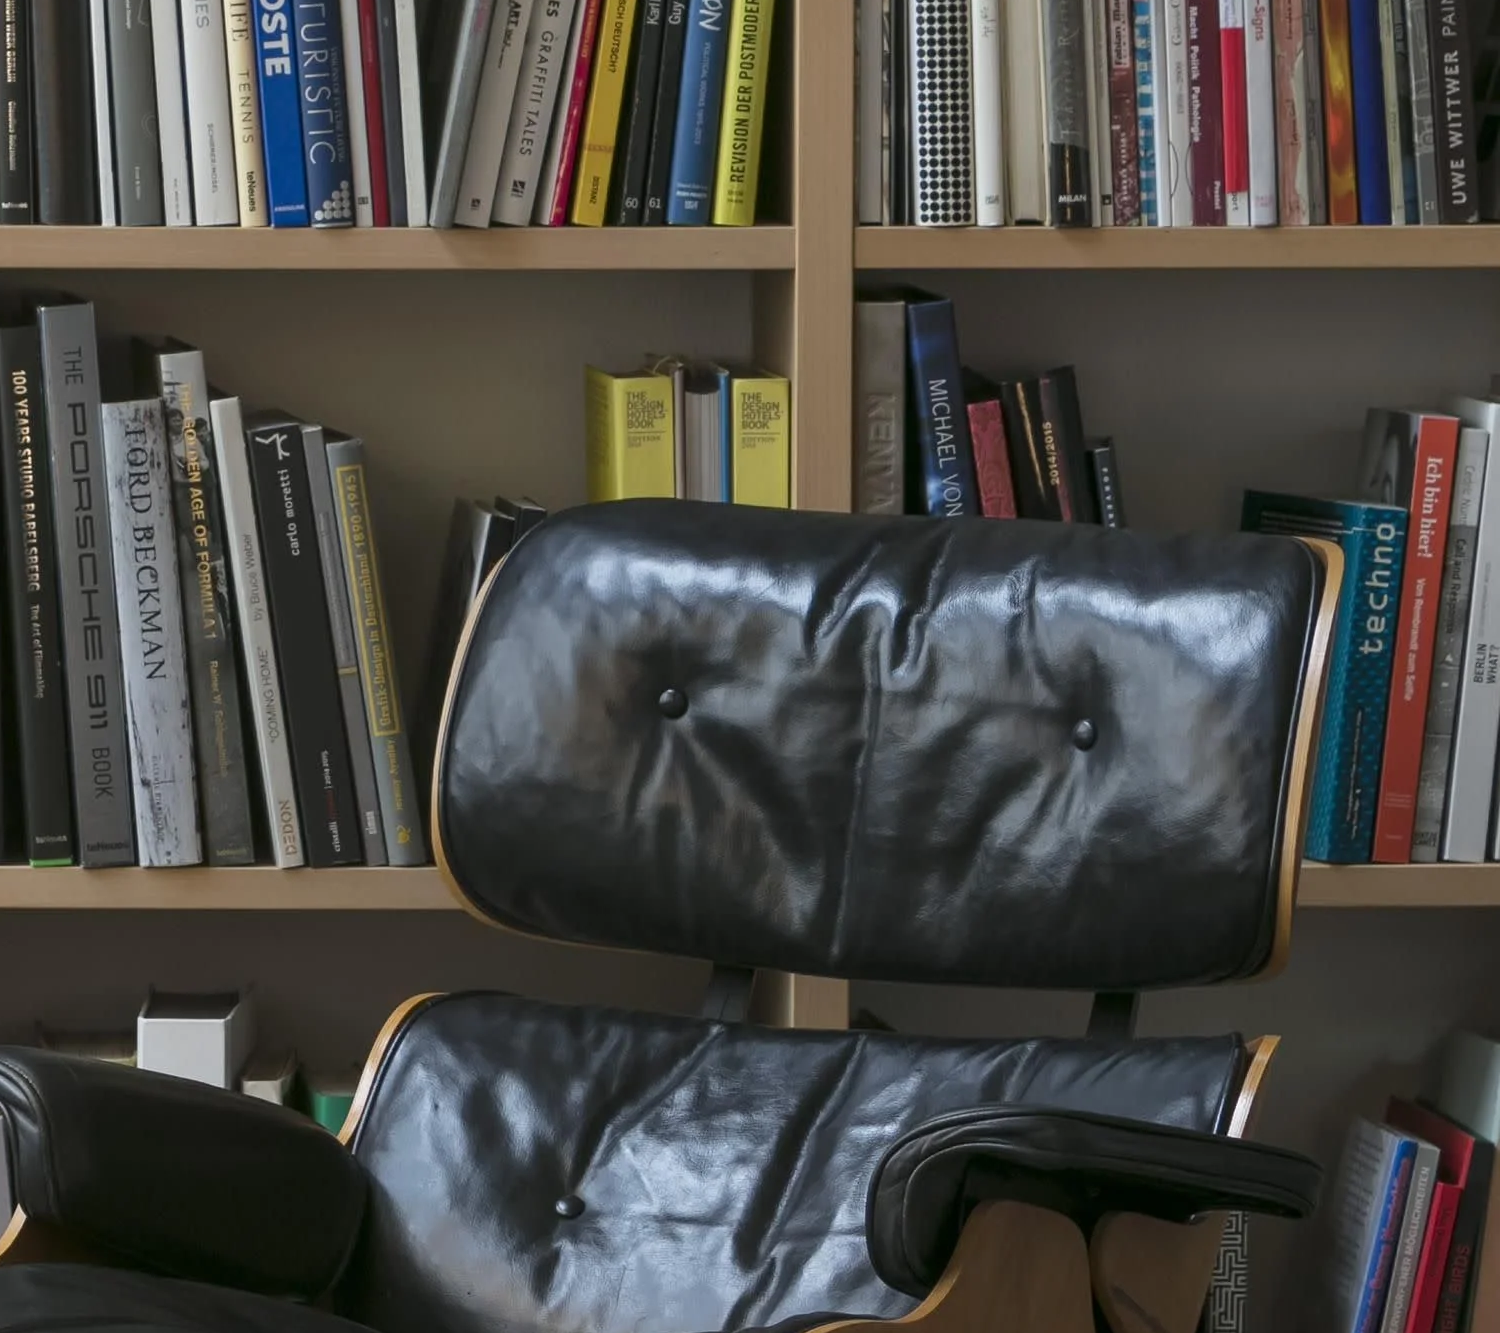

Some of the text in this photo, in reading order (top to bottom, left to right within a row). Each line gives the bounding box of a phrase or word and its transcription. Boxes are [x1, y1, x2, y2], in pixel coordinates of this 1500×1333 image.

[647, 3, 661, 25] Karl
[669, 1, 682, 25] Guy
[530, 31, 554, 102] GRAFFITI
[238, 72, 253, 144] TENNIS
[736, 86, 752, 112] DER
[1444, 50, 1464, 148] WITTWER
[520, 110, 538, 156] TALES
[730, 118, 749, 183] REVISION
[245, 171, 256, 212] teNeues
[1451, 159, 1467, 204] UWE
[625, 197, 638, 209] 60
[649, 197, 661, 209] 61
[626, 390, 647, 400] THE
[626, 400, 665, 411] DESIGN
[741, 392, 762, 402] THE
[741, 402, 780, 412] DESIGN
[626, 419, 654, 430] BOOK
[741, 420, 770, 430] BOOK
[928, 379, 963, 517] MICHAEL VON
[278, 469, 300, 556] carlo moretti
[127, 428, 166, 681] FORD BECKMAN
[1359, 522, 1396, 655] techno
[1473, 643, 1487, 684] BERLIN
